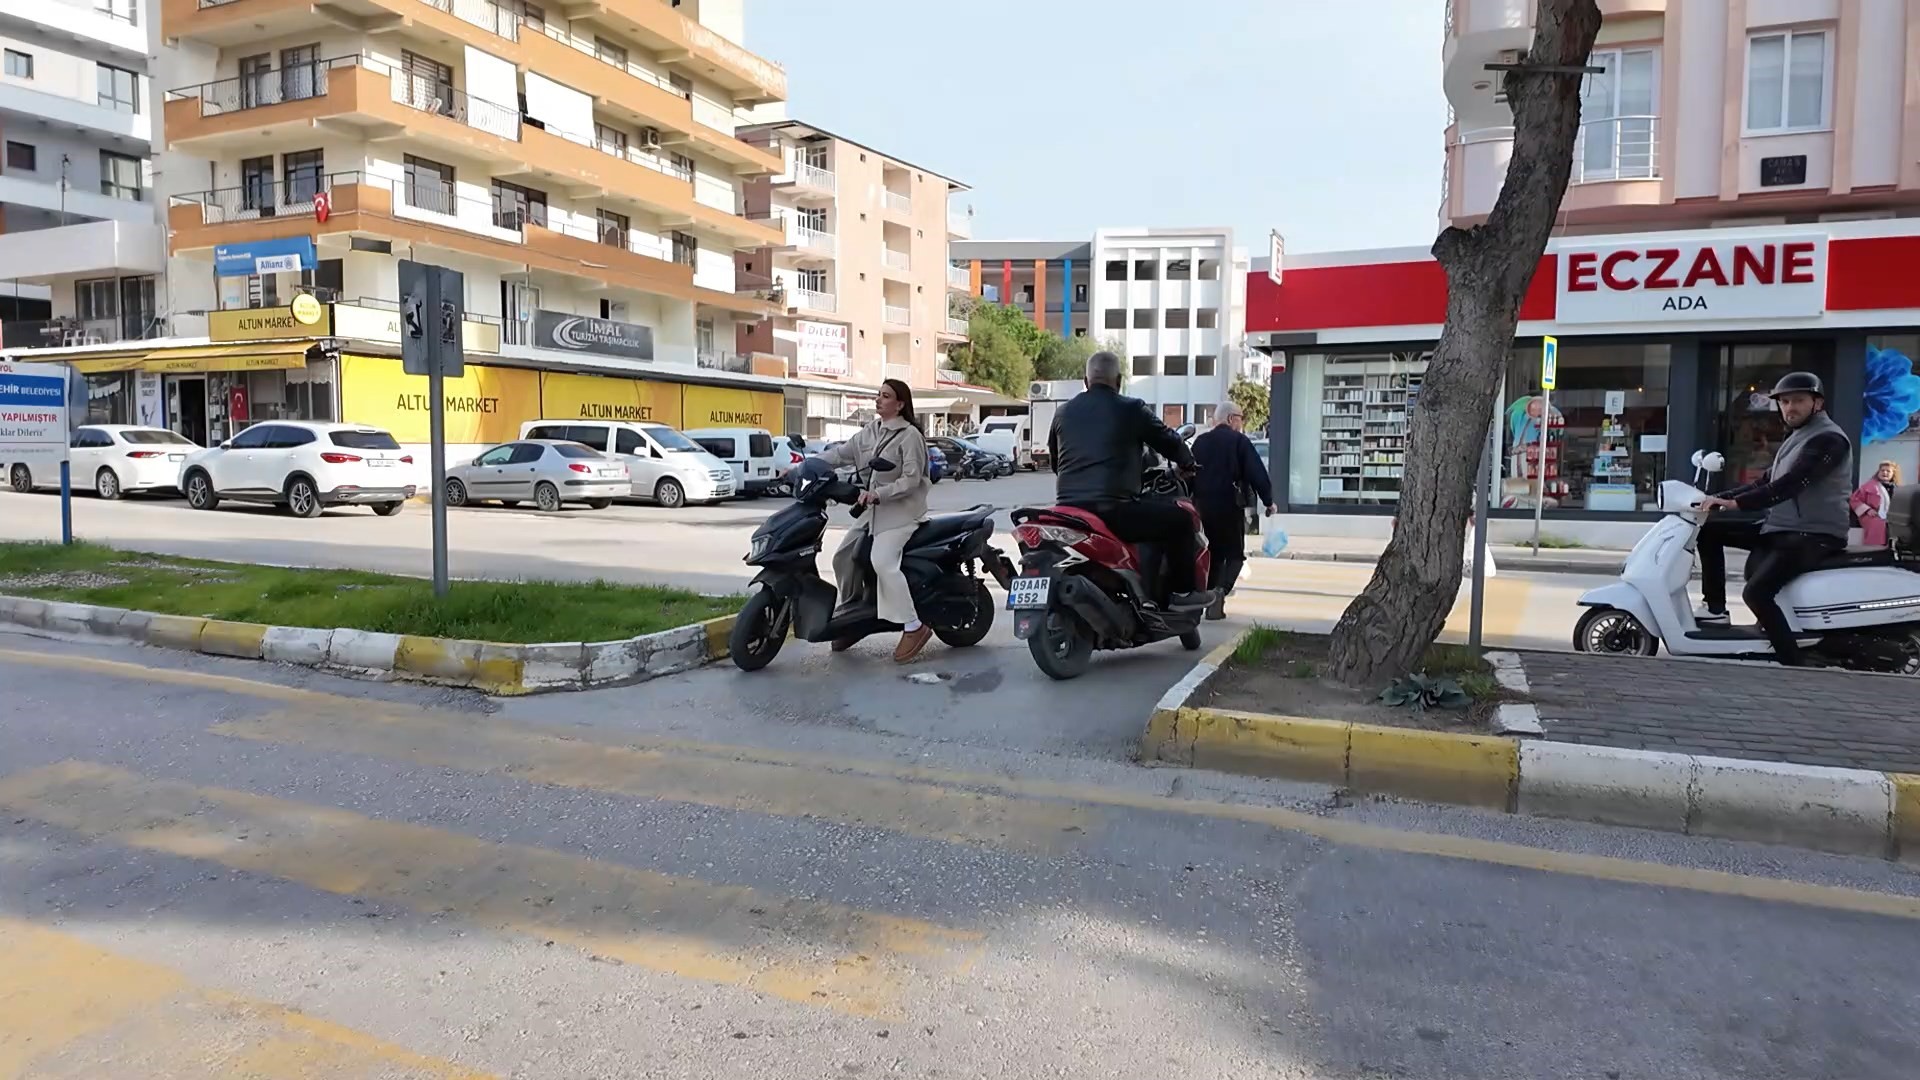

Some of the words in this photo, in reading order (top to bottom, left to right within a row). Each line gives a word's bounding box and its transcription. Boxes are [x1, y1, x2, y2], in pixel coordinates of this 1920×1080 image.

[260, 260, 284, 269] Allianz
[1567, 241, 1815, 292] ECZANE
[1662, 295, 1708, 311] ADA
[238, 319, 263, 330] ALTUN
[265, 317, 297, 329] MARKET
[20, 386, 62, 397] BELEDİYESİ
[397, 394, 431, 412] ALTU
[446, 396, 499, 413] MARKET
[1, 412, 57, 424] YAPILMIŞTIR
[580, 403, 613, 419] ALTUN
[614, 405, 652, 420] MARKET
[710, 411, 734, 423] ALTUN
[735, 412, 763, 425] MARKET
[1013, 580, 1048, 592] 09AAR
[1017, 592, 1039, 603] 552
